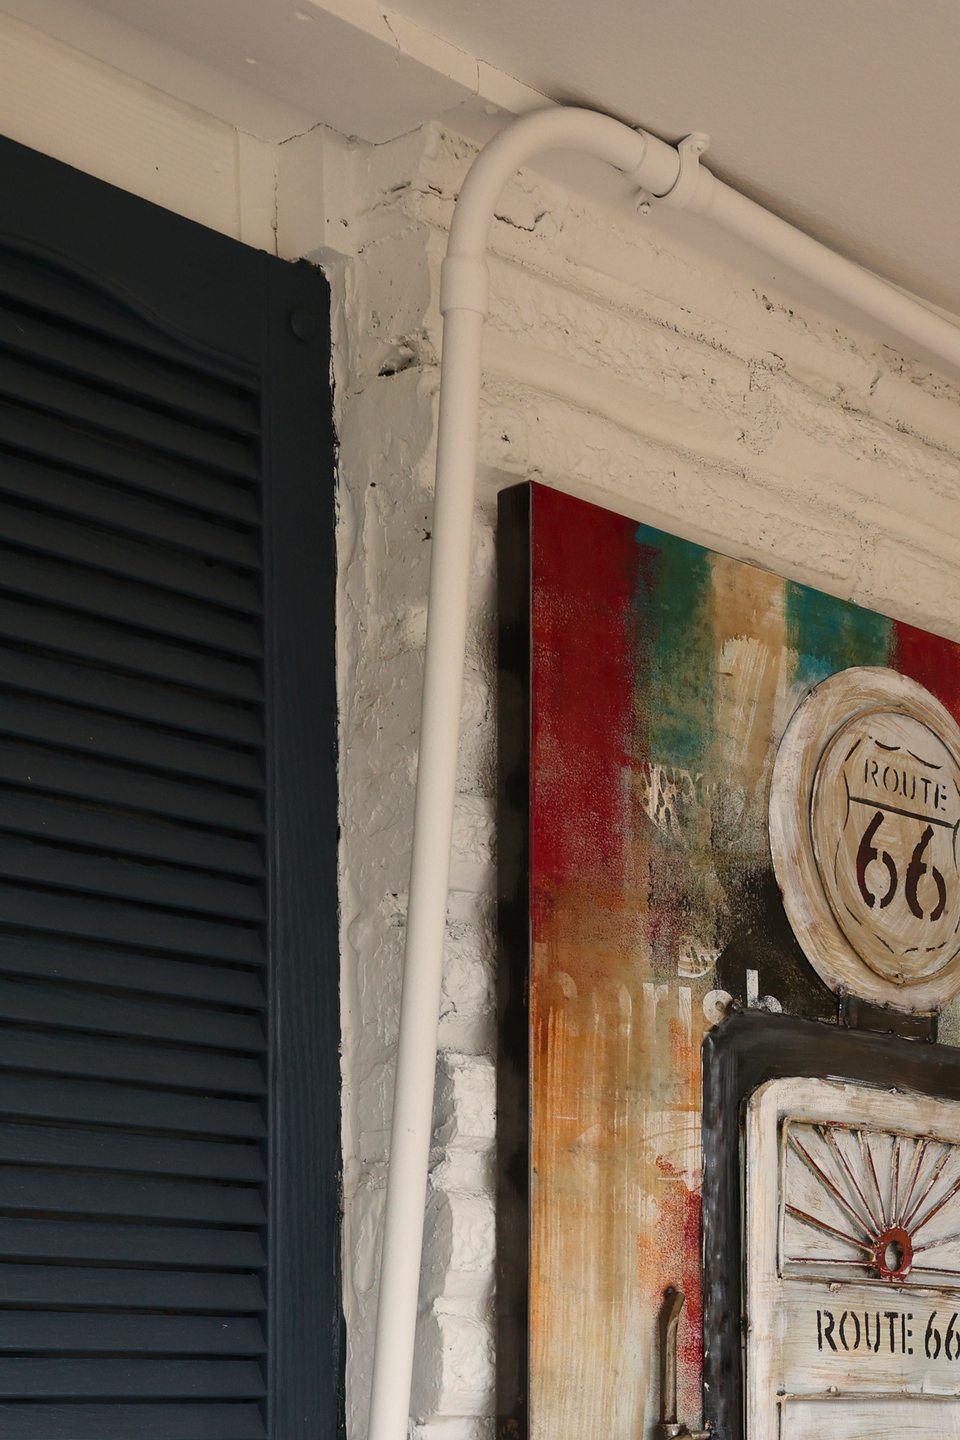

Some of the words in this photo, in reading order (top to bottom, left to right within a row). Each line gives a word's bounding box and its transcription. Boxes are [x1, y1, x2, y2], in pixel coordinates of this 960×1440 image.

[864, 758, 948, 812] ROUTE
[856, 811, 948, 922] 66
[816, 1309, 914, 1356] ROUTE
